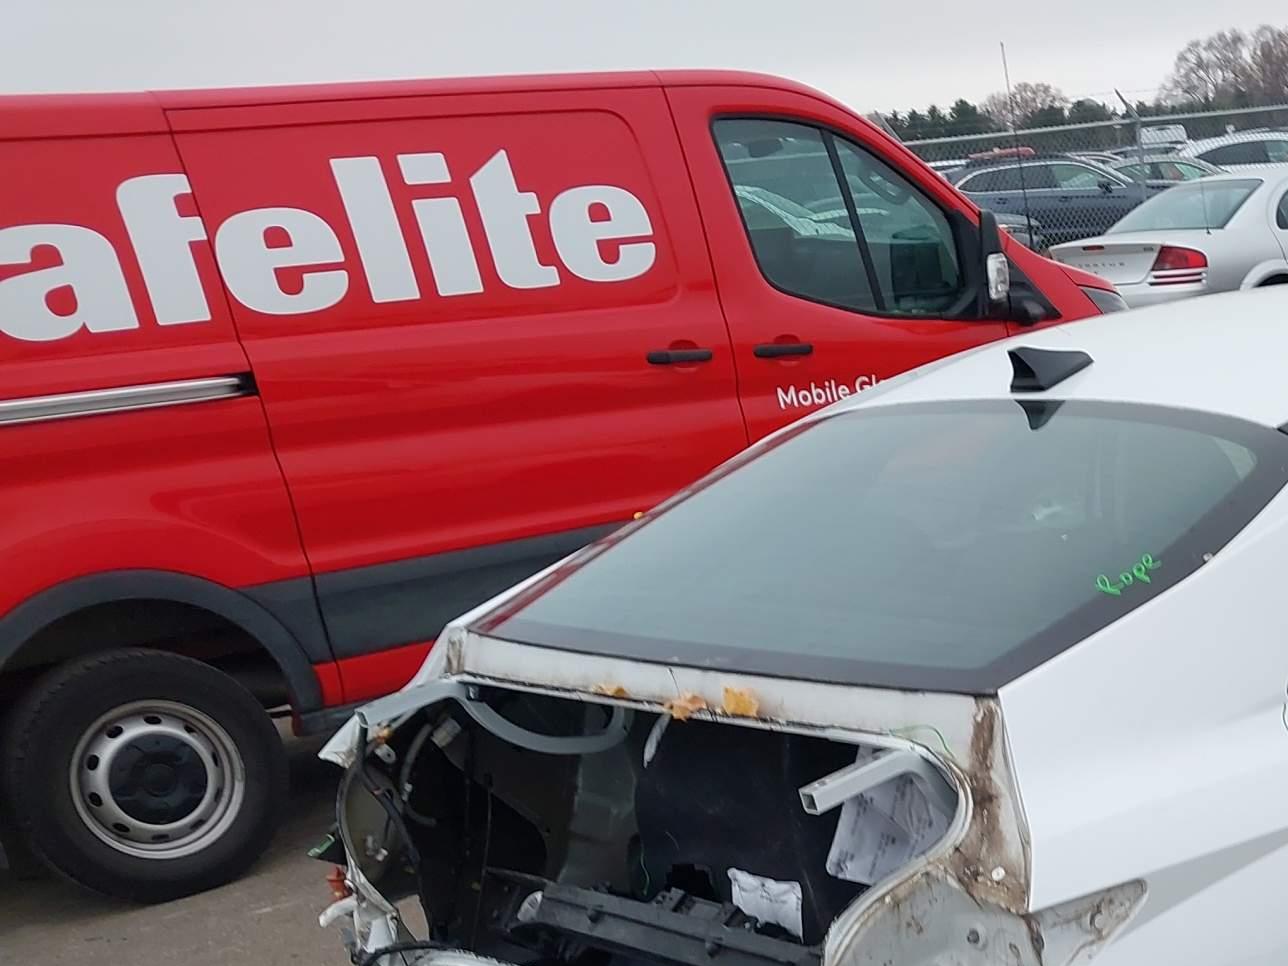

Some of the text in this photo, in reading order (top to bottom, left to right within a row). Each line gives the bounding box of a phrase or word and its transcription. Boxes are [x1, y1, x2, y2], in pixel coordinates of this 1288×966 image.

[0, 149, 656, 342] afelite
[776, 375, 885, 409] Mobile Gl
